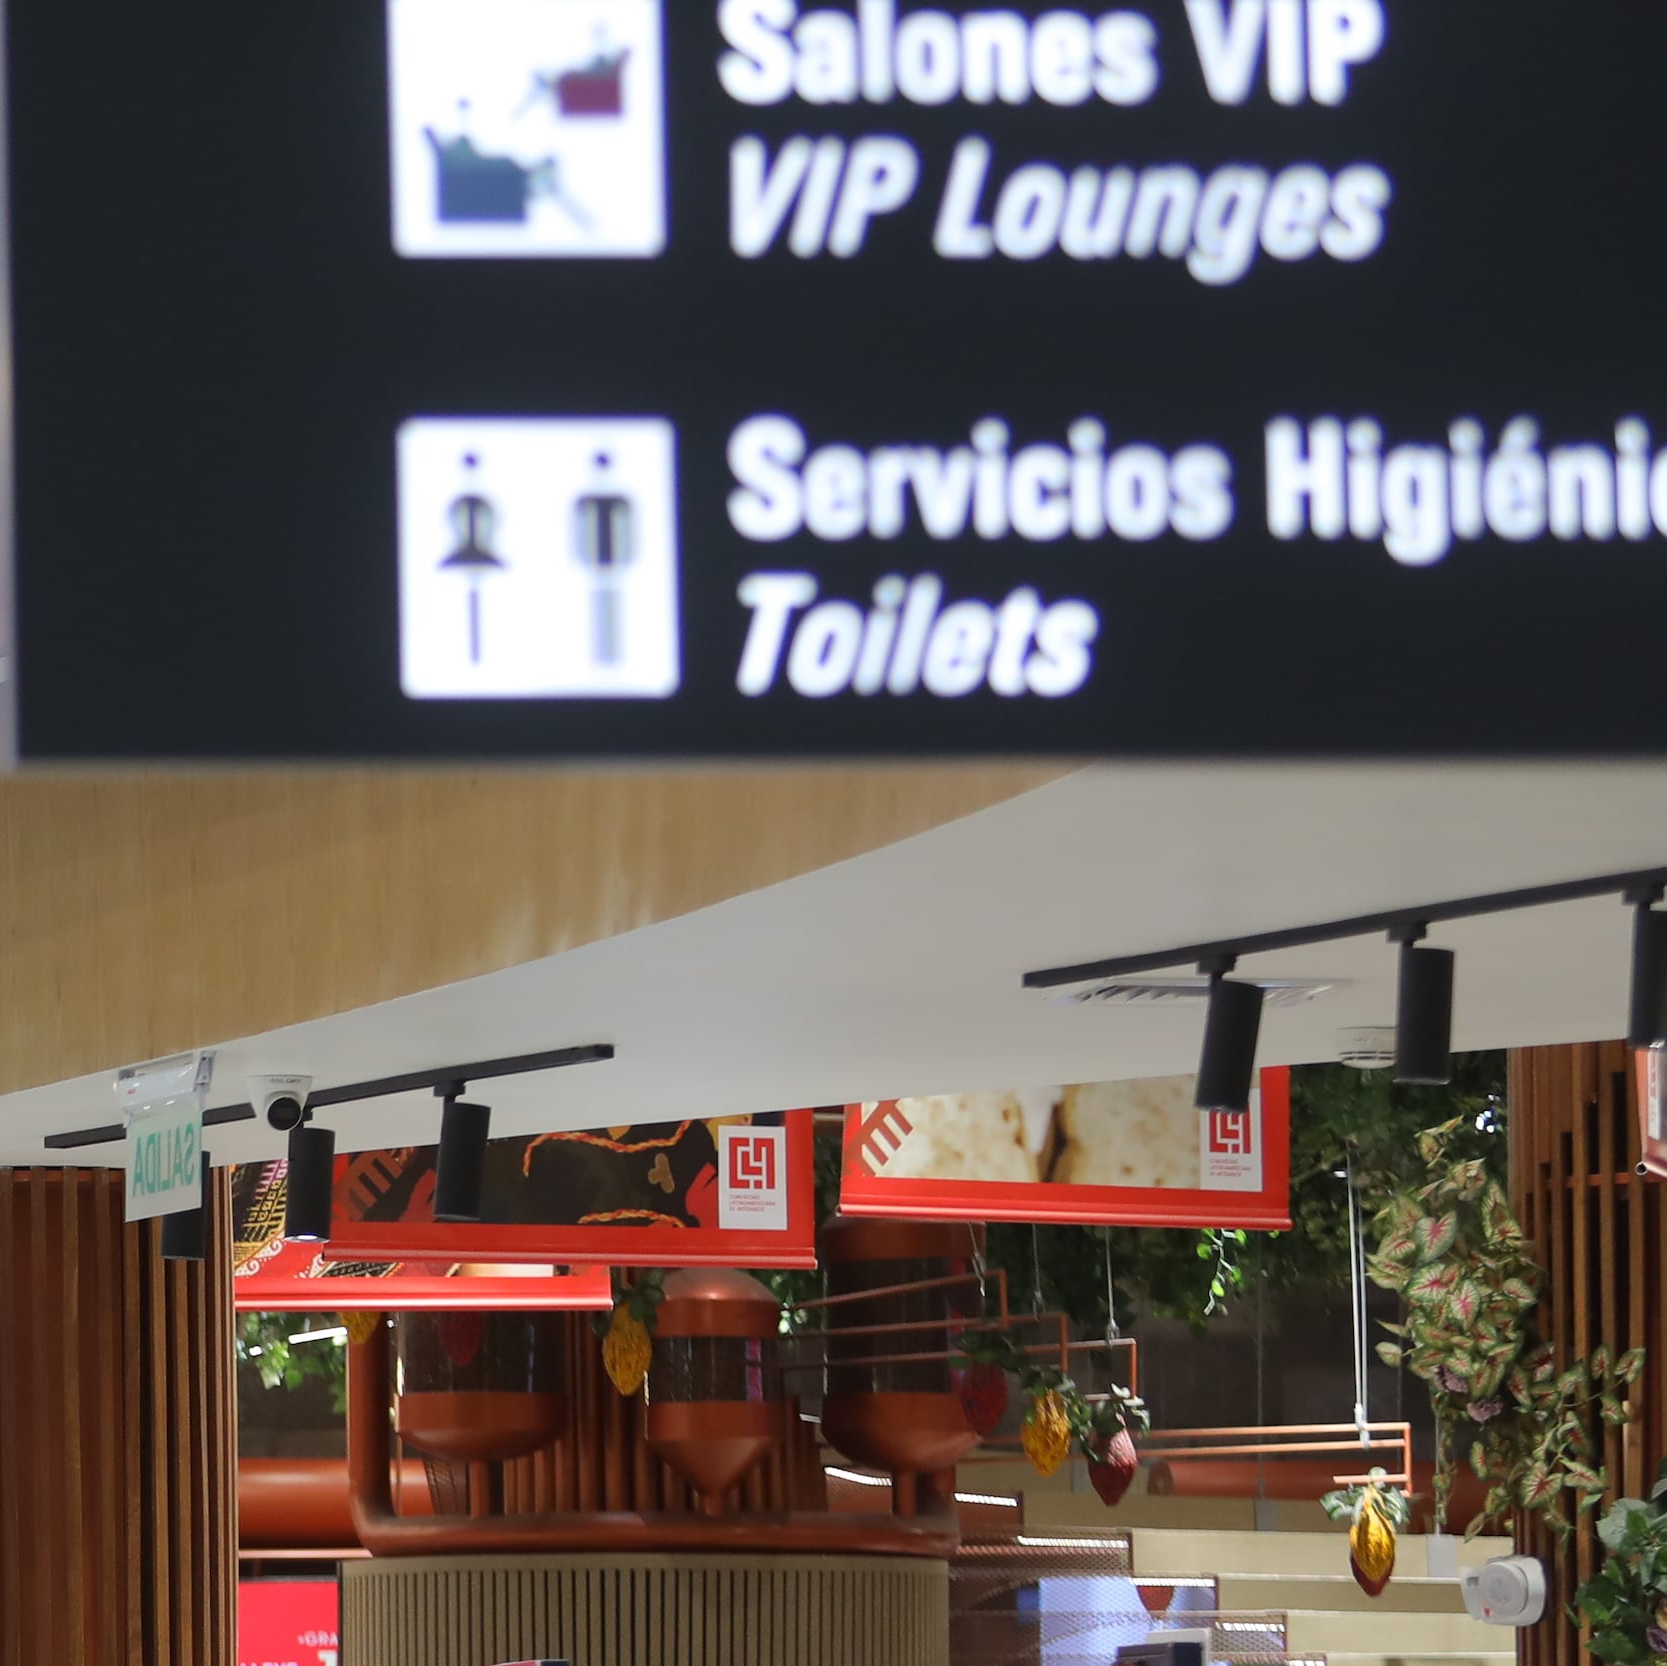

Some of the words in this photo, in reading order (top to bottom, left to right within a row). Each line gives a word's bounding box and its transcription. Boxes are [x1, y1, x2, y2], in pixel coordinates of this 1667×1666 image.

[719, 0, 1156, 107] Salones
[1186, 0, 1385, 107] VIP
[726, 137, 918, 259] VIP
[934, 137, 1391, 287] Lounges
[726, 416, 1232, 542] Servicios
[735, 571, 1098, 698] Toilets
